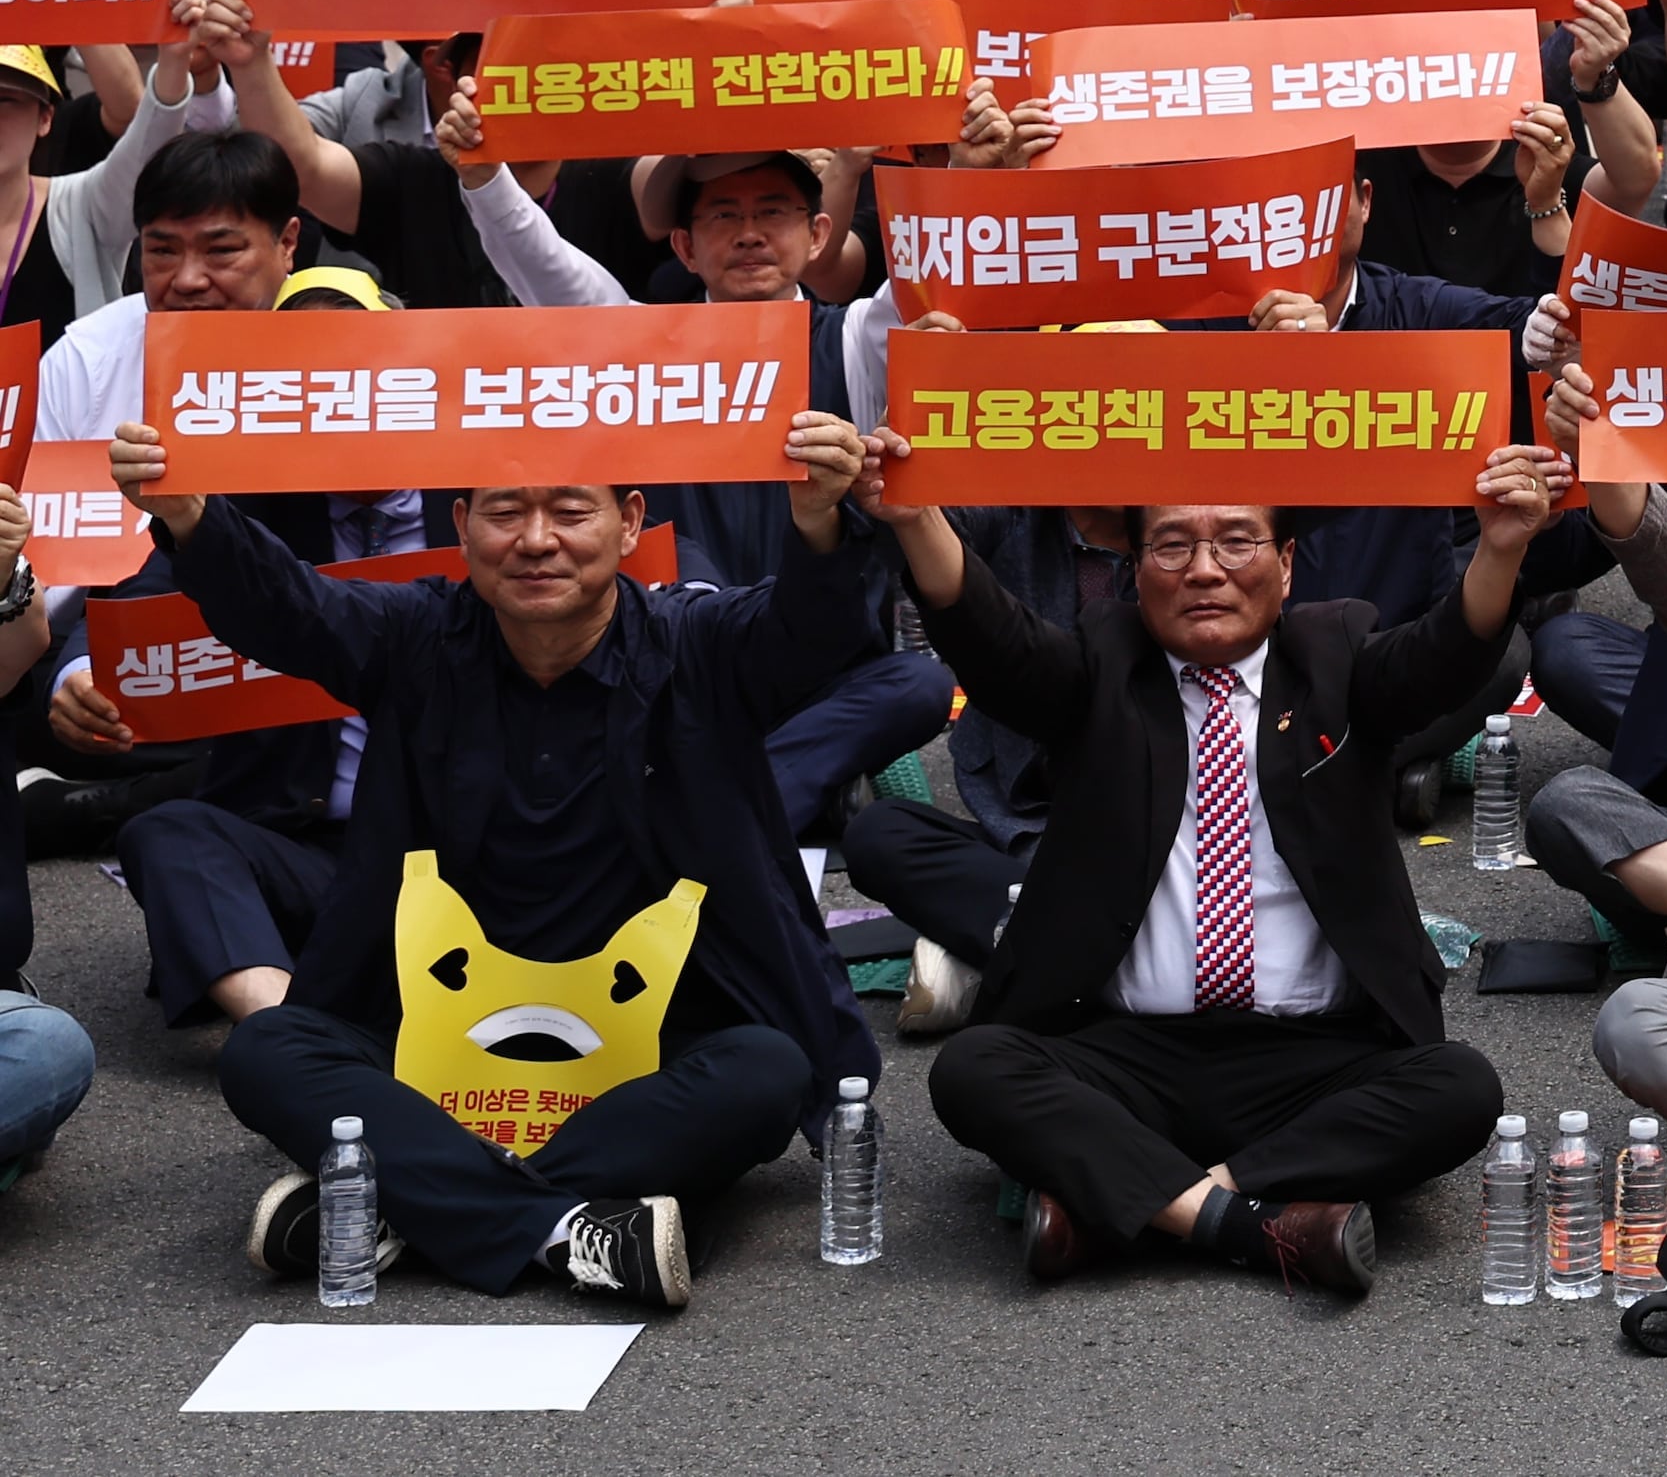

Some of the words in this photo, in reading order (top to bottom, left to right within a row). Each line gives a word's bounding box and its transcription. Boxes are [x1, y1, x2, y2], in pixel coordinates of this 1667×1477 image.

[480, 57, 695, 115] 고용정책
[712, 46, 965, 107] 전환하라!!
[1046, 65, 1253, 124] 생존권을
[1271, 51, 1517, 111] 보장하라!!
[889, 214, 1079, 286] 최저임금
[1098, 184, 1344, 280] 구분적용!!
[172, 368, 438, 435] 생존권을
[461, 361, 780, 429] 보장하라!!
[910, 388, 1164, 450] 고용정책
[1186, 388, 1488, 450] 전환하라!!
[439, 1090, 460, 1115] 더
[464, 1088, 531, 1115] 이상은
